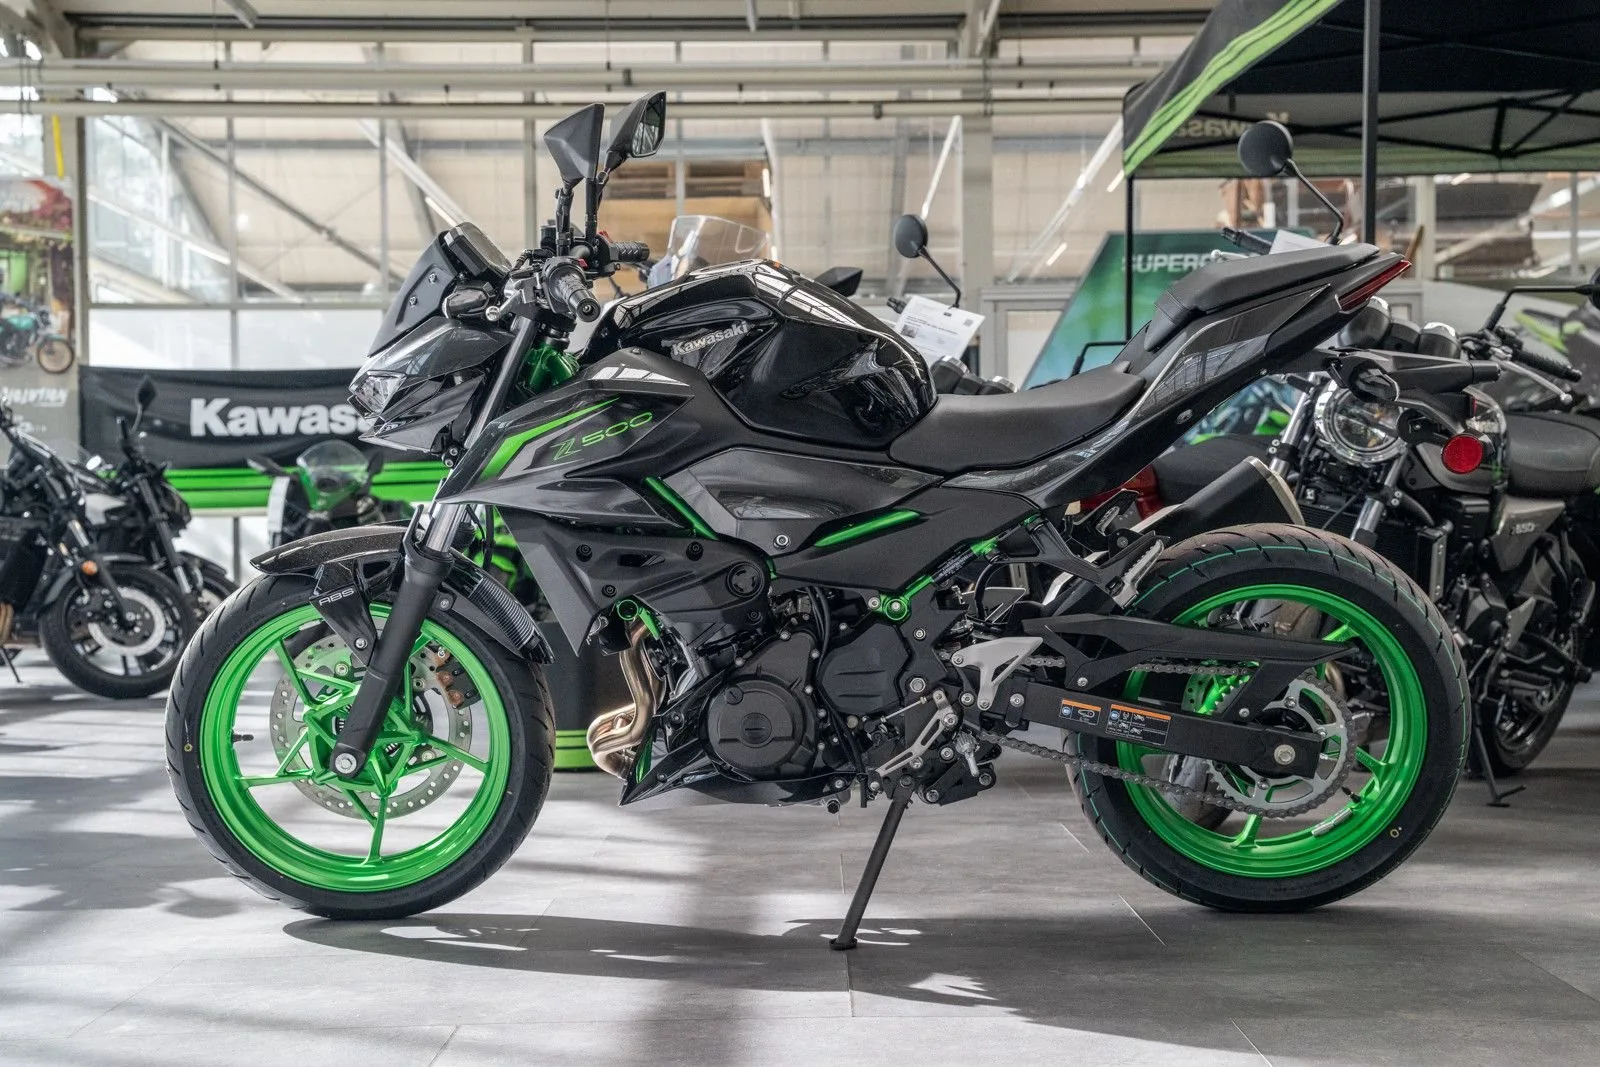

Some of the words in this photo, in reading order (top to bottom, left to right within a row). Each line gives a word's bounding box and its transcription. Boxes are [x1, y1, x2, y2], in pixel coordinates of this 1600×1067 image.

[671, 320, 748, 356] Kawasaki
[550, 411, 654, 461] Z500
[318, 587, 355, 606] ABS
